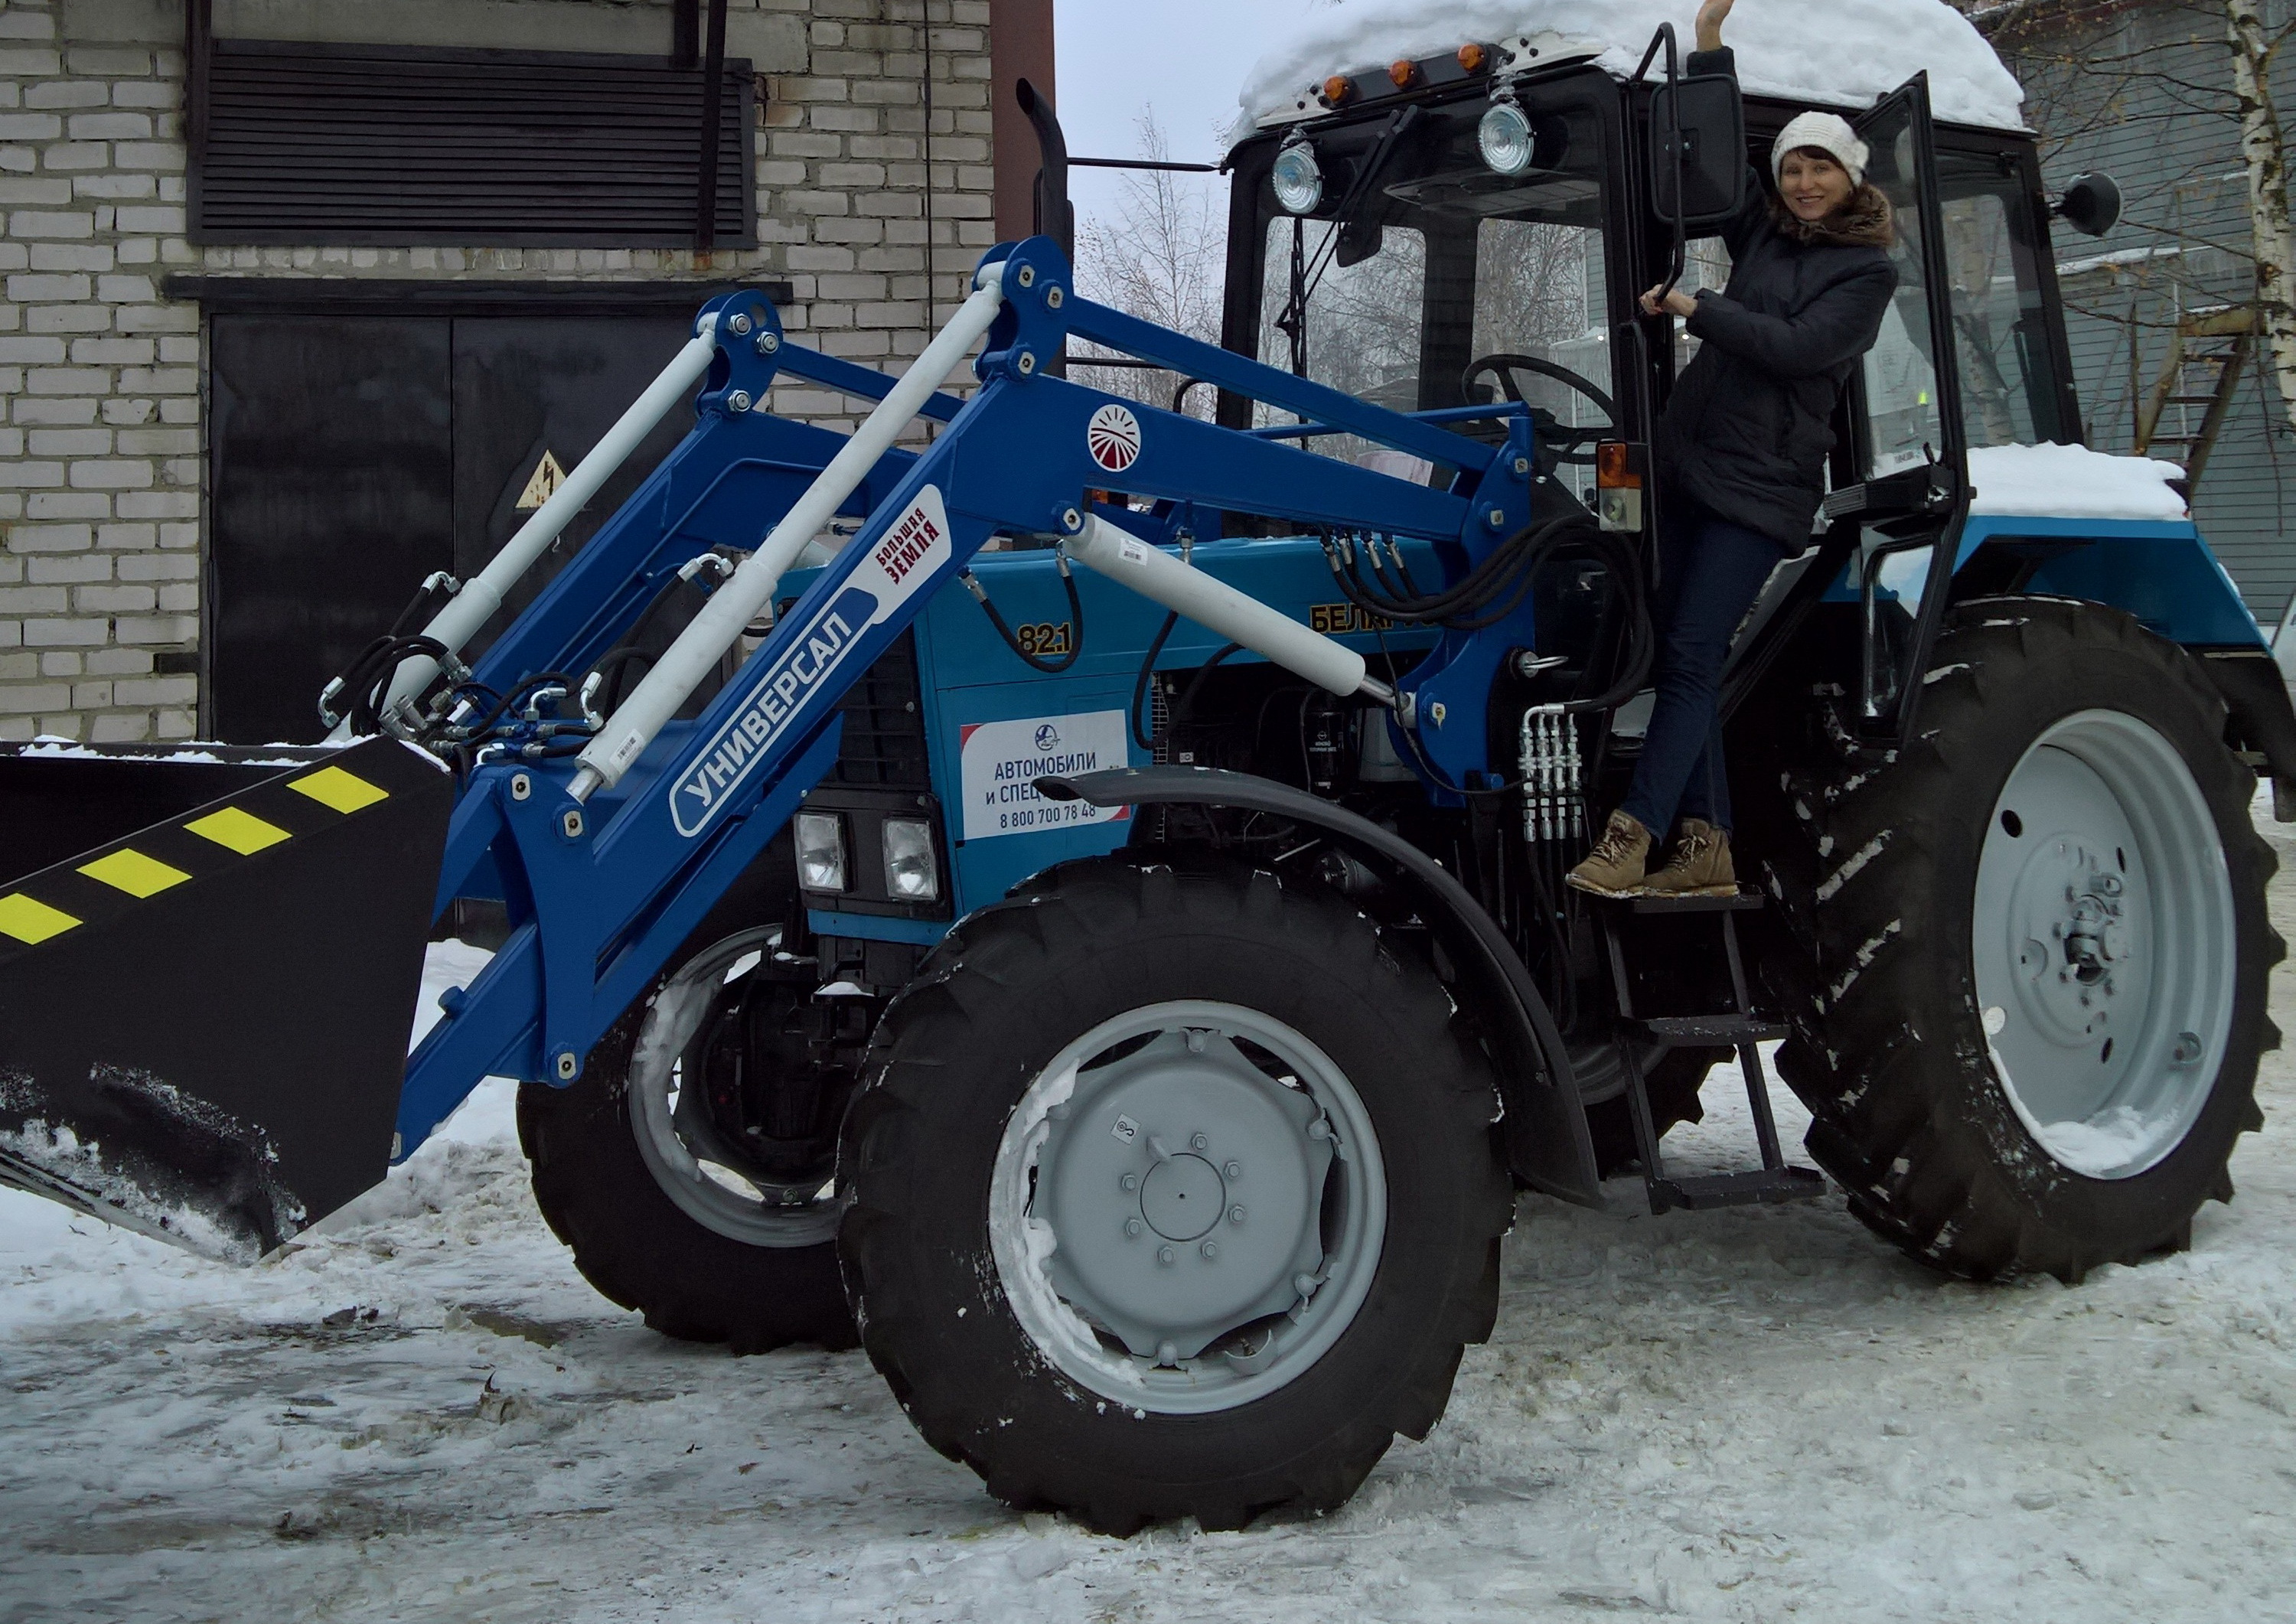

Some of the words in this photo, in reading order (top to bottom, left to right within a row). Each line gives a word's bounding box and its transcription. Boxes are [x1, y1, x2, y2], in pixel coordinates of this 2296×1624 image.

[876, 507, 926, 567] БОЛЬШАЯ
[885, 520, 940, 585] ЗЕМЛЯ
[684, 611, 852, 807] УНИВЕРСАЛ
[994, 752, 1096, 781] АВТОМОБИЛИ
[1000, 782, 1045, 803] СПЕЦ
[1000, 814, 1008, 829] 8
[1012, 810, 1034, 828] 800
[1038, 807, 1061, 824] 700
[1064, 804, 1078, 820] 78
[1081, 804, 1096, 818] 48
